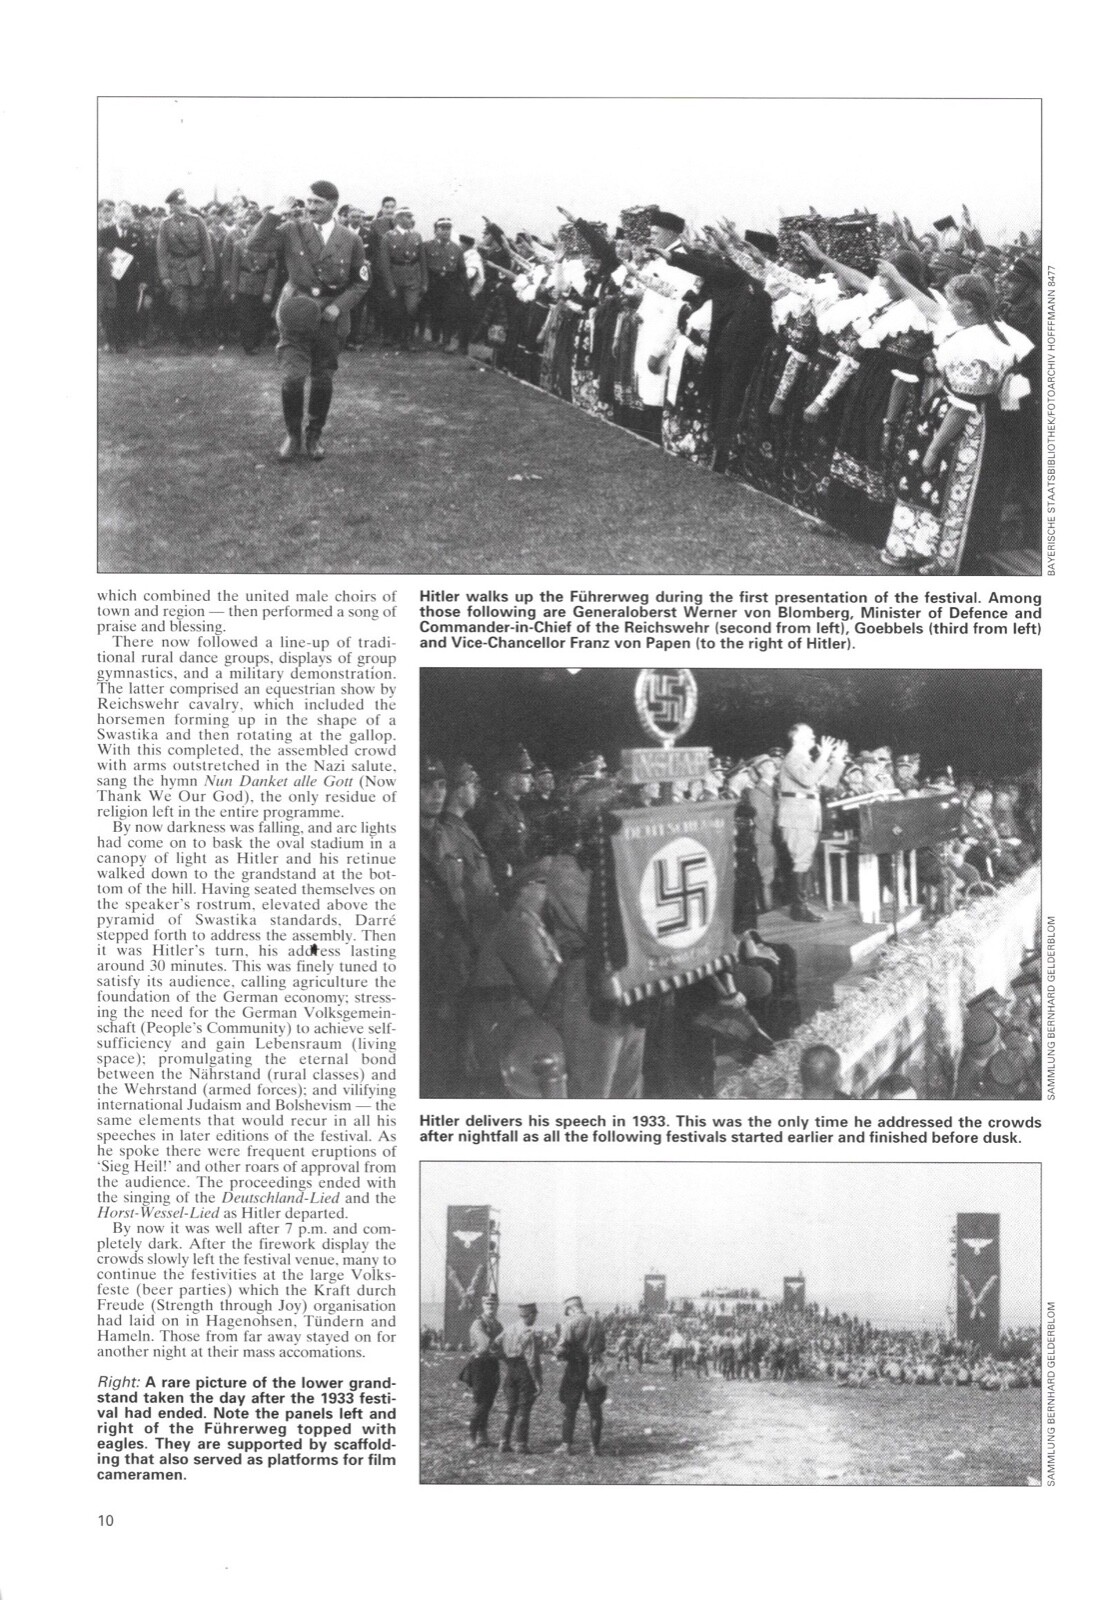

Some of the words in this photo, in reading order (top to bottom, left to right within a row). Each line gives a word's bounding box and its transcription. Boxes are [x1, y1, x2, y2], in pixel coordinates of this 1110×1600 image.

[1047, 266, 1056, 286] 8477
[1047, 290, 1056, 350] HOFFFMANN
[1047, 354, 1056, 513] STAATSBIBLIOTHEK/FOTOARCHIV
[1047, 517, 1056, 575] BAYERISCHE
[97, 589, 136, 601] which
[144, 590, 210, 601] combined
[218, 590, 238, 601] the
[246, 590, 288, 601] united
[296, 590, 328, 601] male
[335, 590, 376, 601] choirs
[383, 590, 395, 601] of
[420, 590, 460, 602] Hitler
[466, 590, 508, 602] walks
[515, 593, 533, 605] up
[539, 591, 563, 602] the
[570, 591, 649, 605] Führerweg
[656, 591, 703, 605] during
[709, 591, 733, 603] the
[739, 591, 768, 603] first
[775, 591, 867, 605] presentation
[875, 591, 888, 603] of
[894, 591, 918, 603] the
[925, 592, 981, 603] festival.
[988, 592, 1041, 605] Among
[419, 606, 461, 617] those
[467, 606, 536, 620] following
[543, 609, 566, 618] are
[573, 606, 677, 618] Generaloberst
[684, 606, 737, 618] Werner
[744, 610, 771, 618] von
[778, 607, 853, 620] Blomberg,
[861, 607, 921, 618] Minister
[928, 607, 942, 618] of
[950, 607, 1008, 619] Defence
[1015, 607, 1041, 619] and
[420, 621, 571, 633] Commander-in-Chief
[577, 621, 591, 633] of
[595, 621, 619, 633] the
[625, 621, 709, 633] Reichswehr
[715, 622, 771, 636] (second
[776, 622, 811, 634] from
[817, 622, 849, 636] left),
[855, 622, 923, 634] Goebbels
[929, 622, 968, 636] (third
[973, 622, 1007, 634] from
[1013, 622, 1041, 636] left)
[116, 636, 153, 647] There
[162, 639, 190, 647] now
[198, 636, 257, 647] followed
[266, 639, 272, 647] a
[281, 636, 329, 651] line-up
[337, 636, 349, 648] of
[359, 636, 395, 648] tradi-
[420, 636, 447, 648] and
[452, 636, 566, 648] Vice-Chancellor
[570, 637, 609, 648] Franz
[614, 640, 641, 649] von
[646, 637, 690, 651] Papen
[696, 637, 715, 651] (to
[720, 637, 744, 649] the
[749, 637, 783, 651] right
[788, 637, 802, 649] of
[807, 637, 855, 651] Hitler).
[98, 698, 179, 709] Reichswehr
[189, 698, 243, 712] cavalry,
[254, 698, 293, 709] which
[305, 698, 363, 709] included
[375, 698, 396, 709] the
[98, 914, 154, 928] pyramid
[168, 914, 180, 925] of
[196, 914, 256, 925] Swastika
[270, 914, 341, 927] standards,
[356, 914, 396, 926] Darré
[1047, 917, 1056, 982] GELDERBLOM
[1047, 985, 1056, 1038] BERNHARD
[1047, 1042, 1056, 1100] SAMMLUNG
[420, 1114, 460, 1126] Hitler
[466, 1115, 522, 1126] delivers
[529, 1115, 550, 1127] his
[555, 1115, 606, 1129] speech
[613, 1115, 625, 1127] in
[633, 1115, 669, 1127] 1933.
[676, 1115, 706, 1127] This
[713, 1119, 742, 1127] was
[748, 1115, 772, 1127] the
[778, 1115, 809, 1130] only
[815, 1116, 848, 1127] time
[855, 1116, 872, 1128] he
[878, 1116, 952, 1128] addressed
[958, 1116, 982, 1128] the
[988, 1116, 1042, 1128] crowds
[420, 1130, 454, 1142] after
[459, 1130, 518, 1144] nightfall
[523, 1134, 539, 1142] as
[543, 1130, 560, 1142] all
[564, 1130, 588, 1142] the
[592, 1130, 661, 1145] following
[666, 1131, 727, 1143] festivals
[731, 1131, 783, 1143] started
[788, 1131, 833, 1143] earlier
[838, 1131, 865, 1143] and
[869, 1131, 927, 1143] finished
[932, 1131, 978, 1143] before
[983, 1132, 1021, 1143] dusk.
[98, 1207, 219, 1218] Horst-Wessel-Lied
[243, 1207, 281, 1219] Hitler
[285, 1208, 348, 1222] departed.
[98, 1300, 144, 1311] Freude
[151, 1300, 213, 1314] (Strength
[220, 1300, 272, 1314] through
[278, 1300, 307, 1315] Joy)
[314, 1300, 395, 1315] organisation
[1047, 1302, 1056, 1368] GELDERBLOM
[98, 1376, 140, 1391] Right:
[145, 1376, 156, 1388] A
[162, 1380, 190, 1388] rare
[196, 1377, 247, 1391] picture
[253, 1377, 267, 1389] of
[272, 1377, 296, 1389] the
[302, 1377, 343, 1389] lower
[349, 1377, 396, 1392] grand-
[97, 1391, 137, 1403] stand
[143, 1392, 184, 1403] taken
[190, 1392, 214, 1404] the
[220, 1392, 245, 1406] day
[251, 1392, 285, 1404] after
[290, 1392, 314, 1404] the
[321, 1392, 354, 1404] 1933
[359, 1392, 396, 1404] festi-
[1047, 1371, 1056, 1424] BERNHARD
[97, 1407, 118, 1418] val
[125, 1407, 151, 1419] had
[158, 1407, 206, 1419] ended.
[214, 1407, 249, 1419] Note
[255, 1407, 279, 1419] the
[285, 1407, 333, 1422] panels
[340, 1407, 363, 1419] left
[369, 1408, 396, 1420] and
[98, 1422, 133, 1436] right
[144, 1422, 159, 1434] of
[169, 1422, 194, 1434] the
[205, 1422, 286, 1437] Führerweg
[297, 1423, 351, 1437] topped
[362, 1423, 396, 1435] with
[1047, 1428, 1056, 1486] SAMMLUNG
[97, 1471, 186, 1479] cameramen.
[99, 1515, 113, 1526] 10
